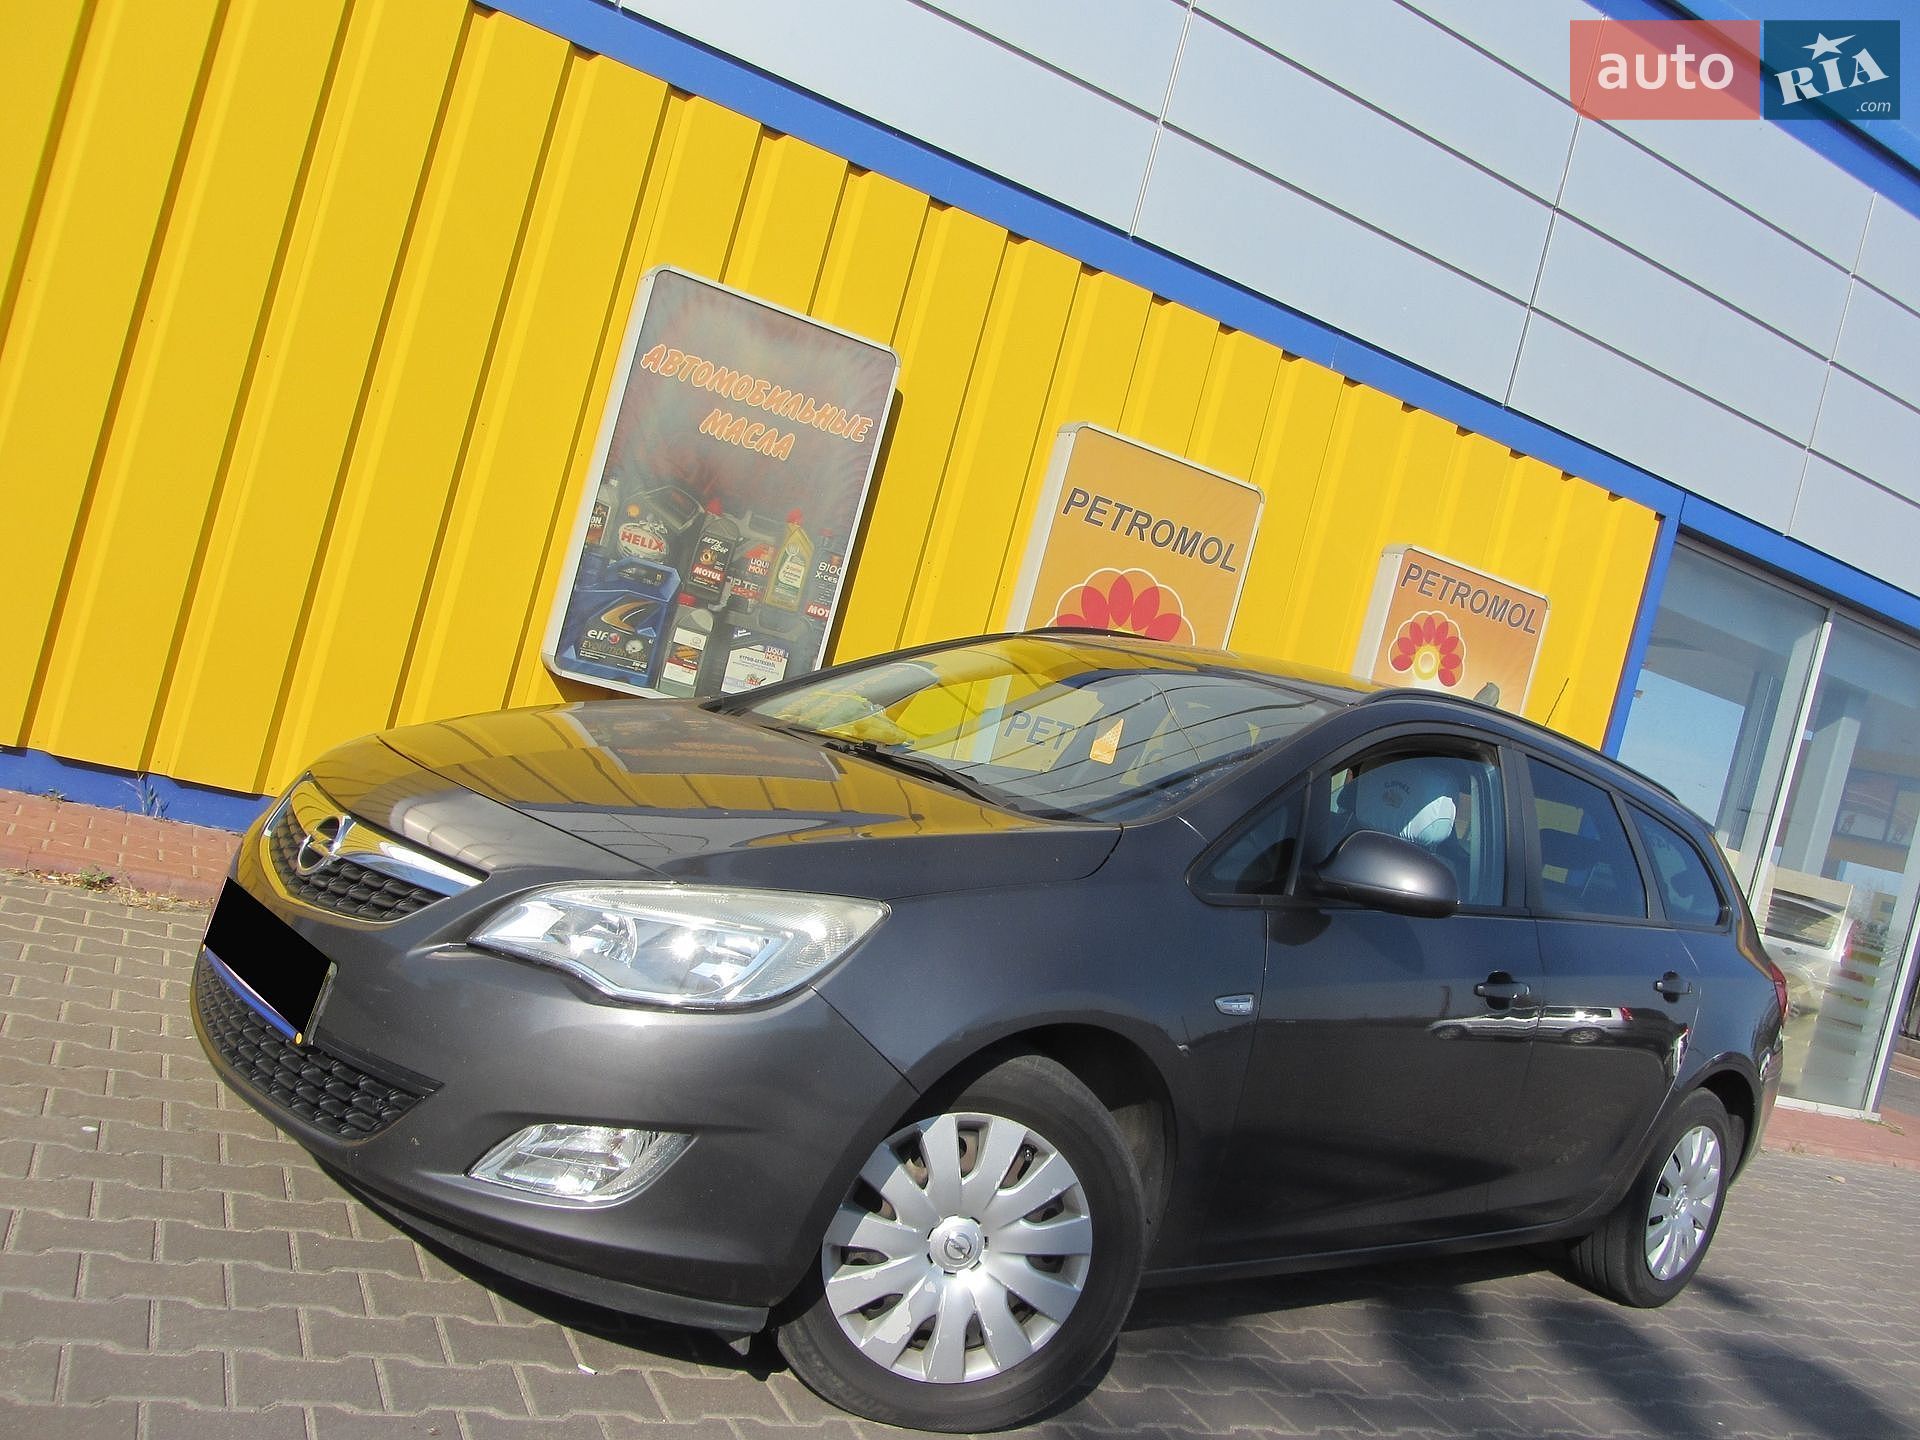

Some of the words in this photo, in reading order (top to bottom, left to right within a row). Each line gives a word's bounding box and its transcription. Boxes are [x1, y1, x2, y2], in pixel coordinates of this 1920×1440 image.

[640, 344, 874, 443] АВТОМОБИЛЬНЫЕ
[699, 408, 795, 461] МАСЛА
[620, 530, 665, 553] HELIX
[1062, 487, 1237, 573] PETROMOL
[693, 566, 722, 582] MOTUL
[1401, 563, 1536, 634] PETROMOL
[587, 629, 609, 641] elf
[1003, 709, 1075, 751] PET
